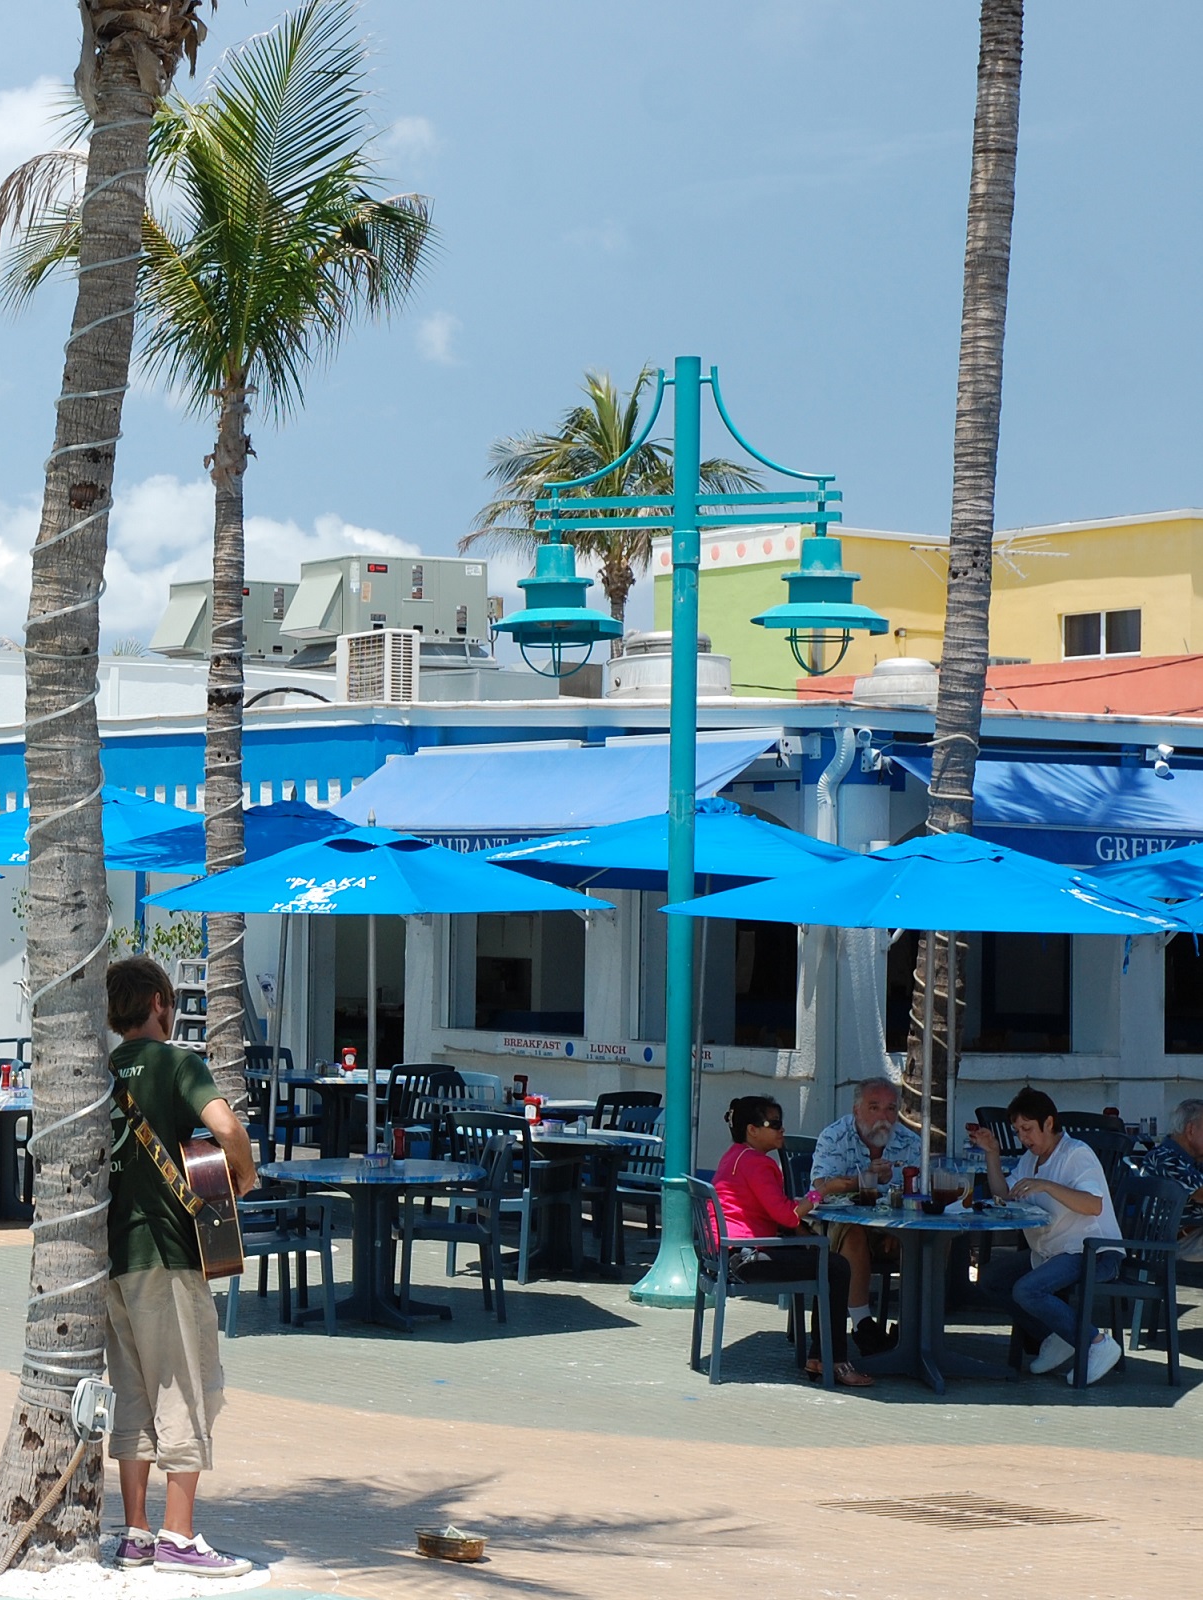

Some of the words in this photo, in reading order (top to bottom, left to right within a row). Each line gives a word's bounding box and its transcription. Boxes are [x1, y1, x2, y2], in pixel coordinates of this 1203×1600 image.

[1096, 836, 1176, 861] GREEK
[285, 876, 377, 890] "PLAKA"
[504, 1038, 561, 1050] BREAKFAST
[590, 1044, 626, 1055] LUNCH
[118, 1065, 145, 1078] MENT
